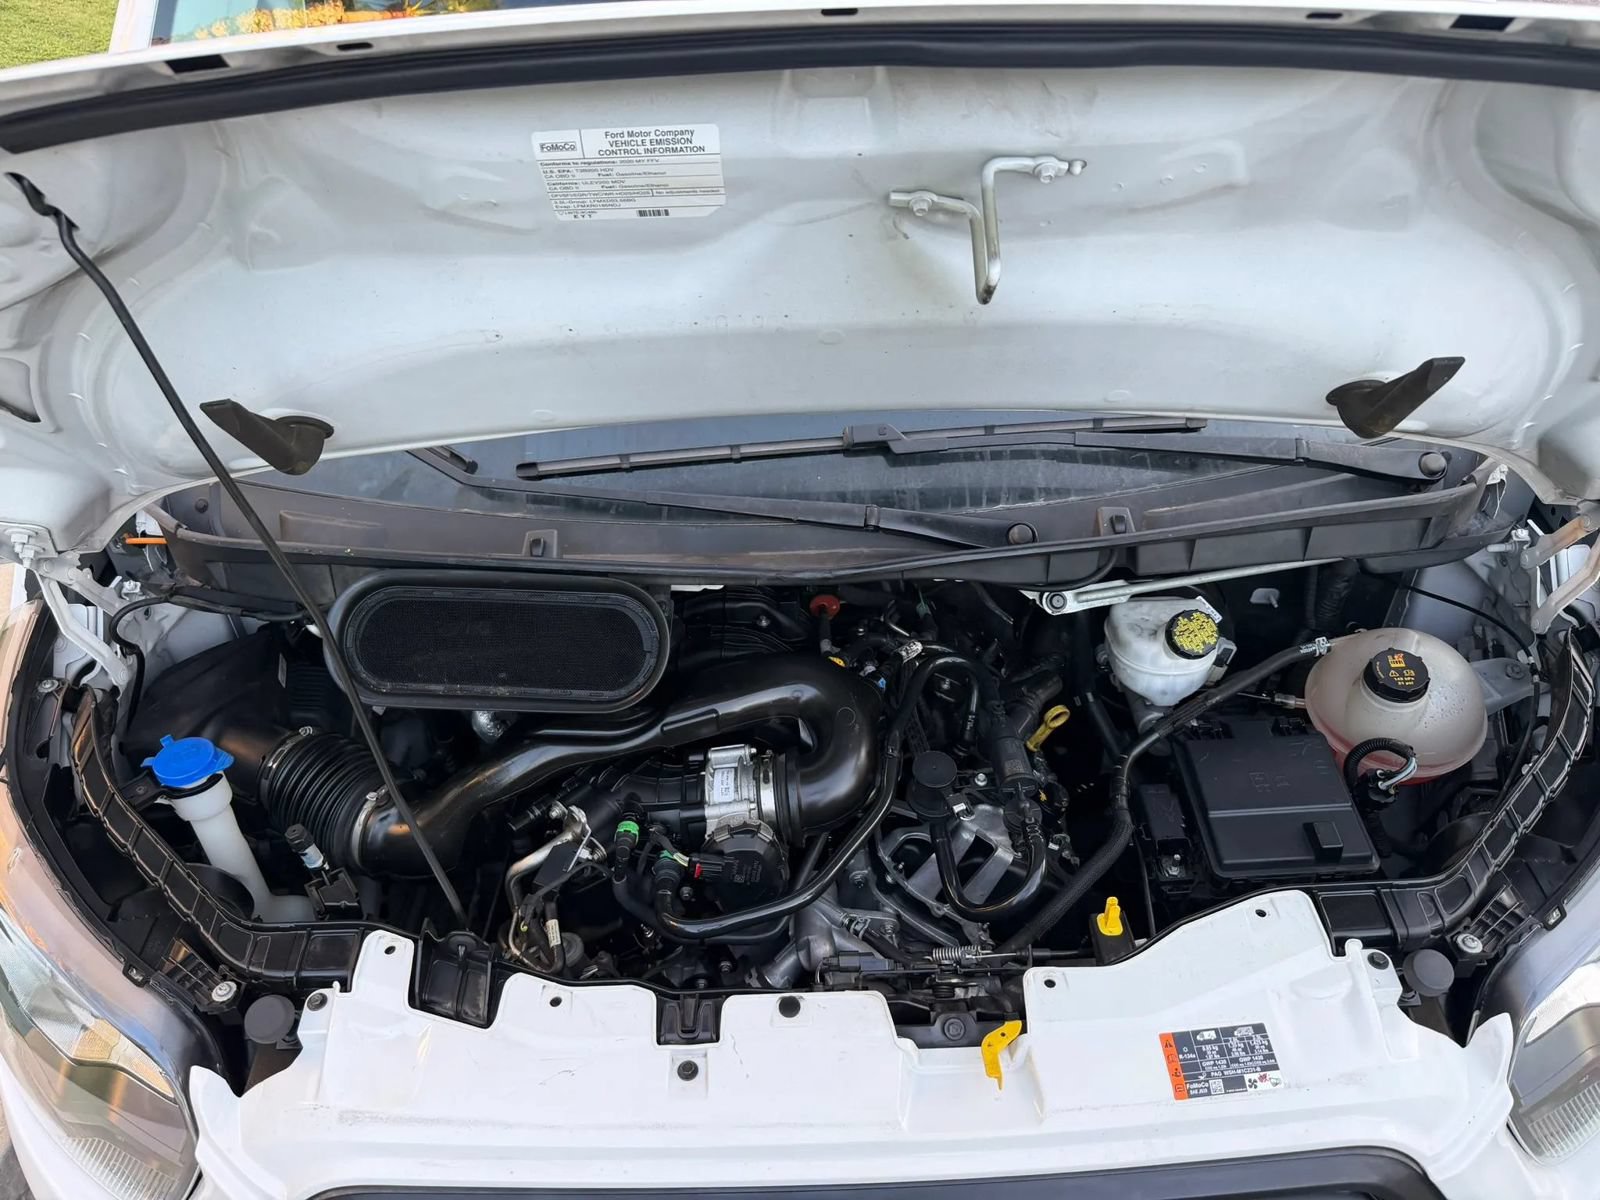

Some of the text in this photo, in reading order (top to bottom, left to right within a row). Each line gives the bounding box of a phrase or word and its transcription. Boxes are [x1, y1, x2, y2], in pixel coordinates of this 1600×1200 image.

[605, 129, 695, 139] Ford Motor Company
[540, 142, 577, 152] FoMoCo
[608, 137, 693, 148] VEHICLE EMISSION
[598, 146, 706, 157] CONTROL INFORMATION
